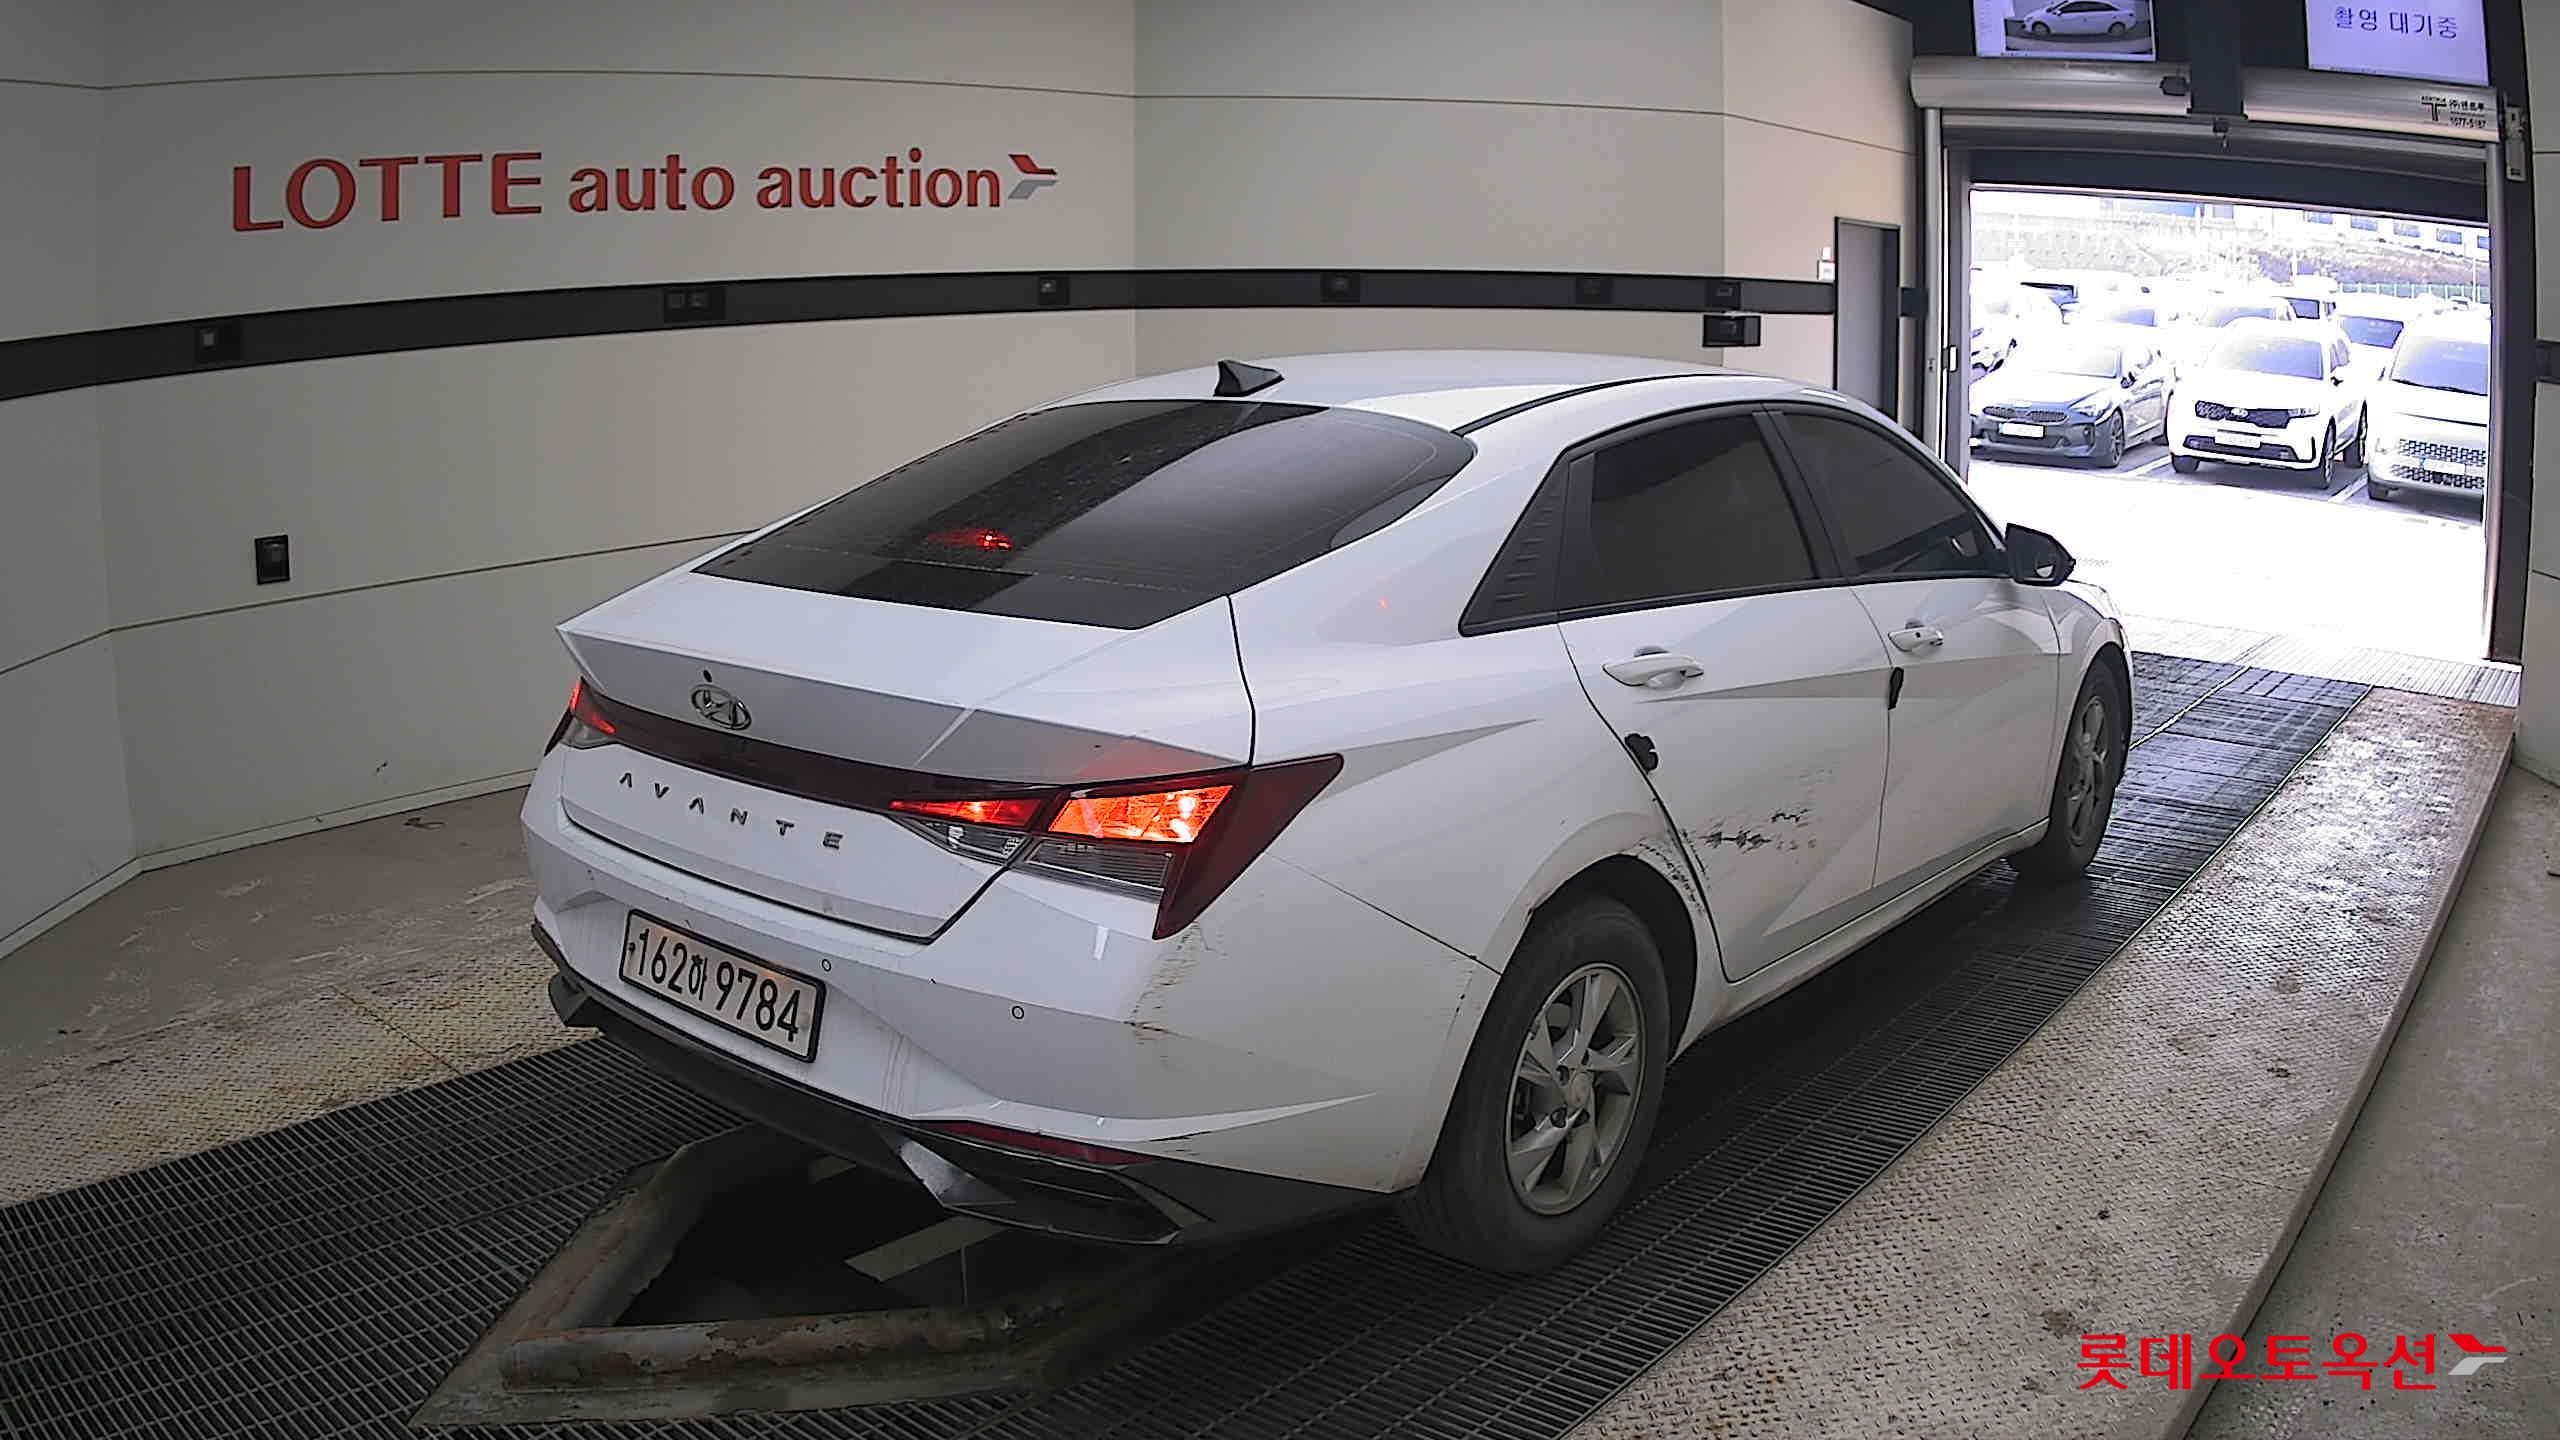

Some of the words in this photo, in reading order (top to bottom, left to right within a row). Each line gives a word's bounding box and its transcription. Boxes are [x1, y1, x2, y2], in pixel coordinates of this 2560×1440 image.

[2335, 6, 2378, 32] 촬영
[2389, 12, 2457, 40] 대기중
[232, 151, 543, 232] LOTTE
[568, 153, 735, 213] auto
[755, 147, 1001, 209] auction
[619, 772, 844, 850] AVANTE
[716, 960, 801, 1042] 9784
